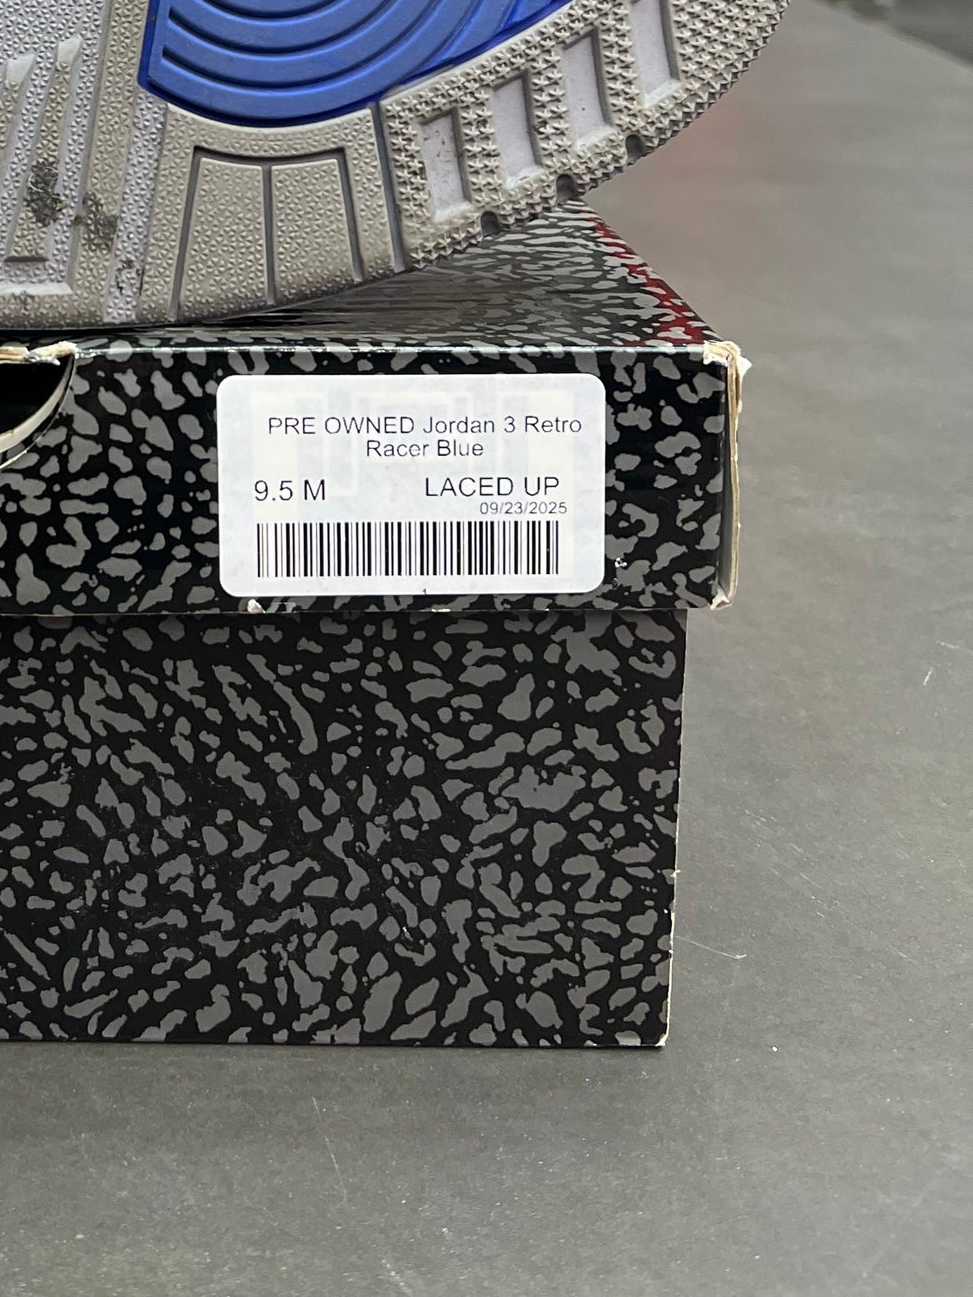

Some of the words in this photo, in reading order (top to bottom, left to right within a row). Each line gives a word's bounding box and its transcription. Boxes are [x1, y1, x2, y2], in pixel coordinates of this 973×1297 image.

[268, 417, 316, 435] PRE
[324, 416, 415, 435] OWNED
[422, 416, 495, 434] Jordan
[503, 416, 516, 434] 3
[524, 415, 582, 434] Retro
[366, 440, 430, 457] Racer
[437, 439, 484, 457] Blue
[254, 480, 294, 502] 9.5
[303, 479, 326, 501] M
[425, 477, 515, 498] LACED
[524, 476, 560, 497] UP
[479, 502, 568, 515] 09/23/2025
